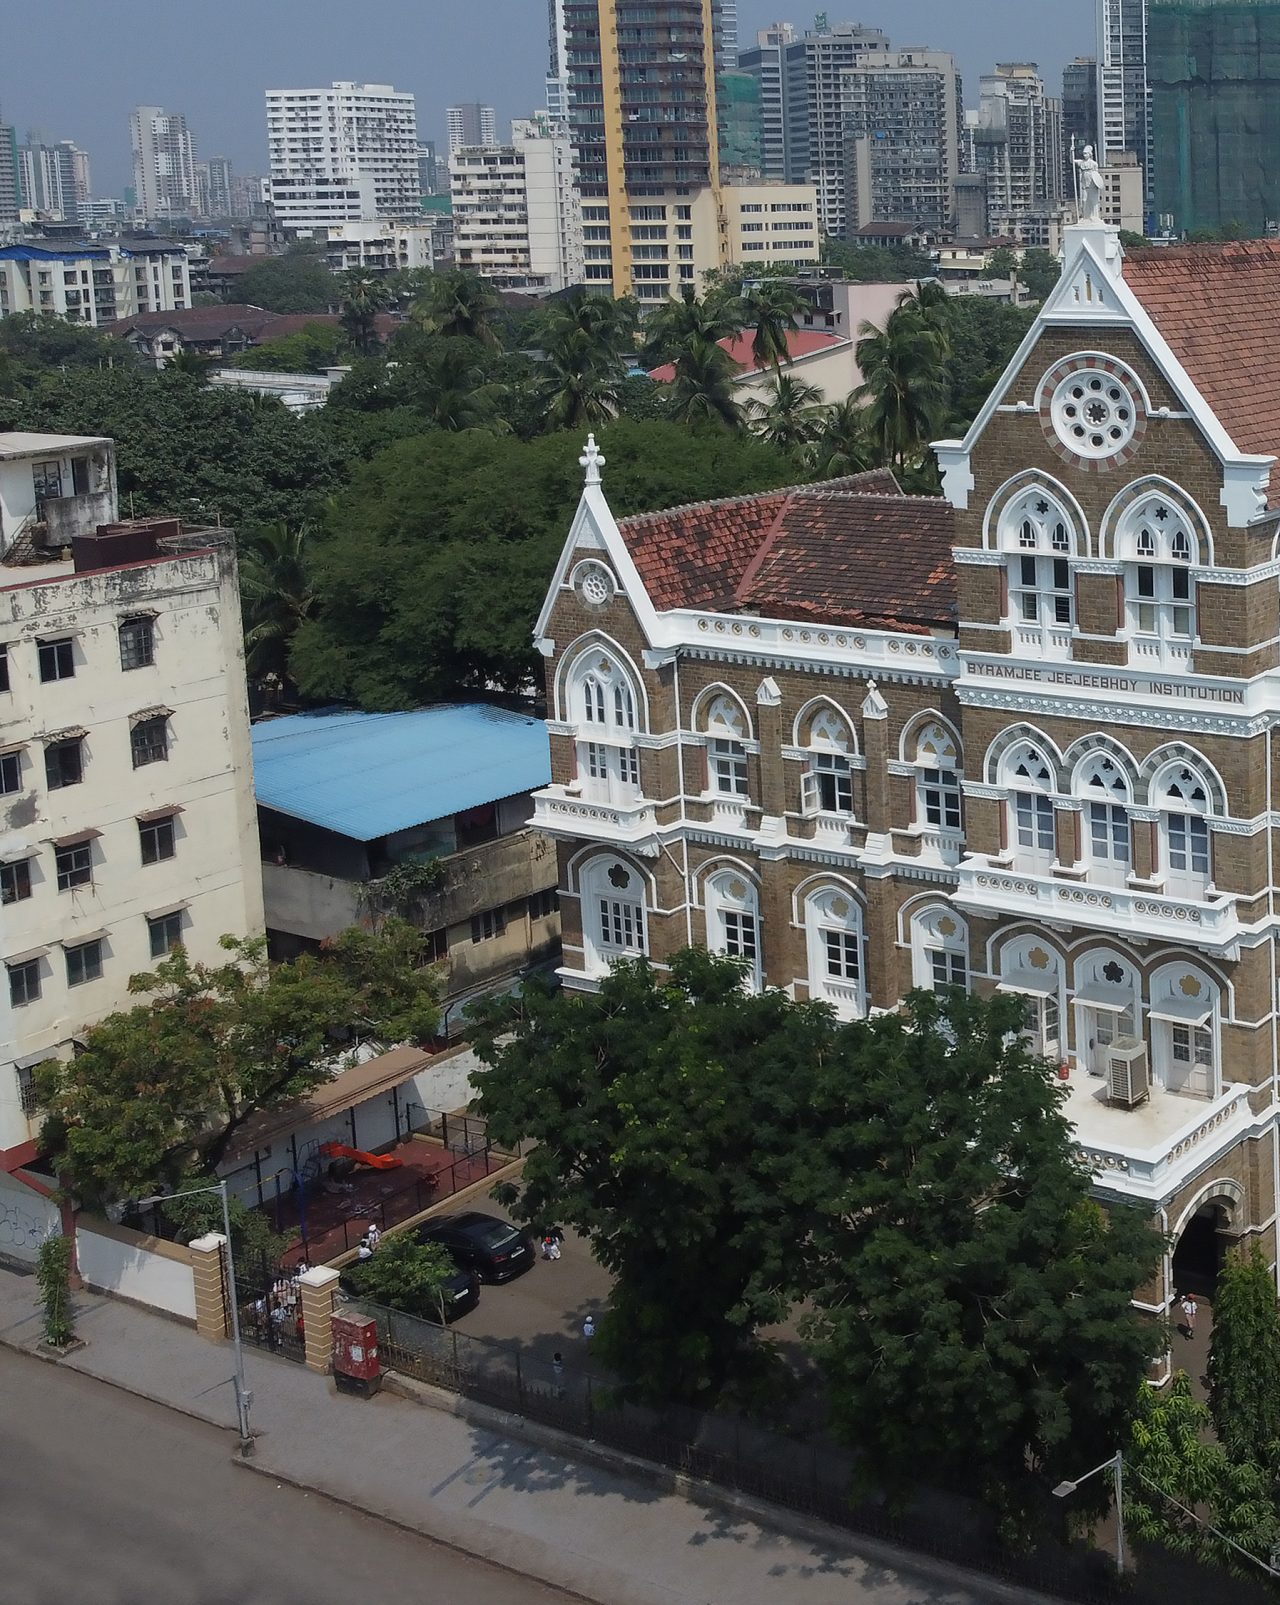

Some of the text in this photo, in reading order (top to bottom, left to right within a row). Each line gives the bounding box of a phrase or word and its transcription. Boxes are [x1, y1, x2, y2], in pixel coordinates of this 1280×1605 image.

[967, 663, 1244, 704] BYRAMJEE JEEJEEBHOY INSTITUTION
